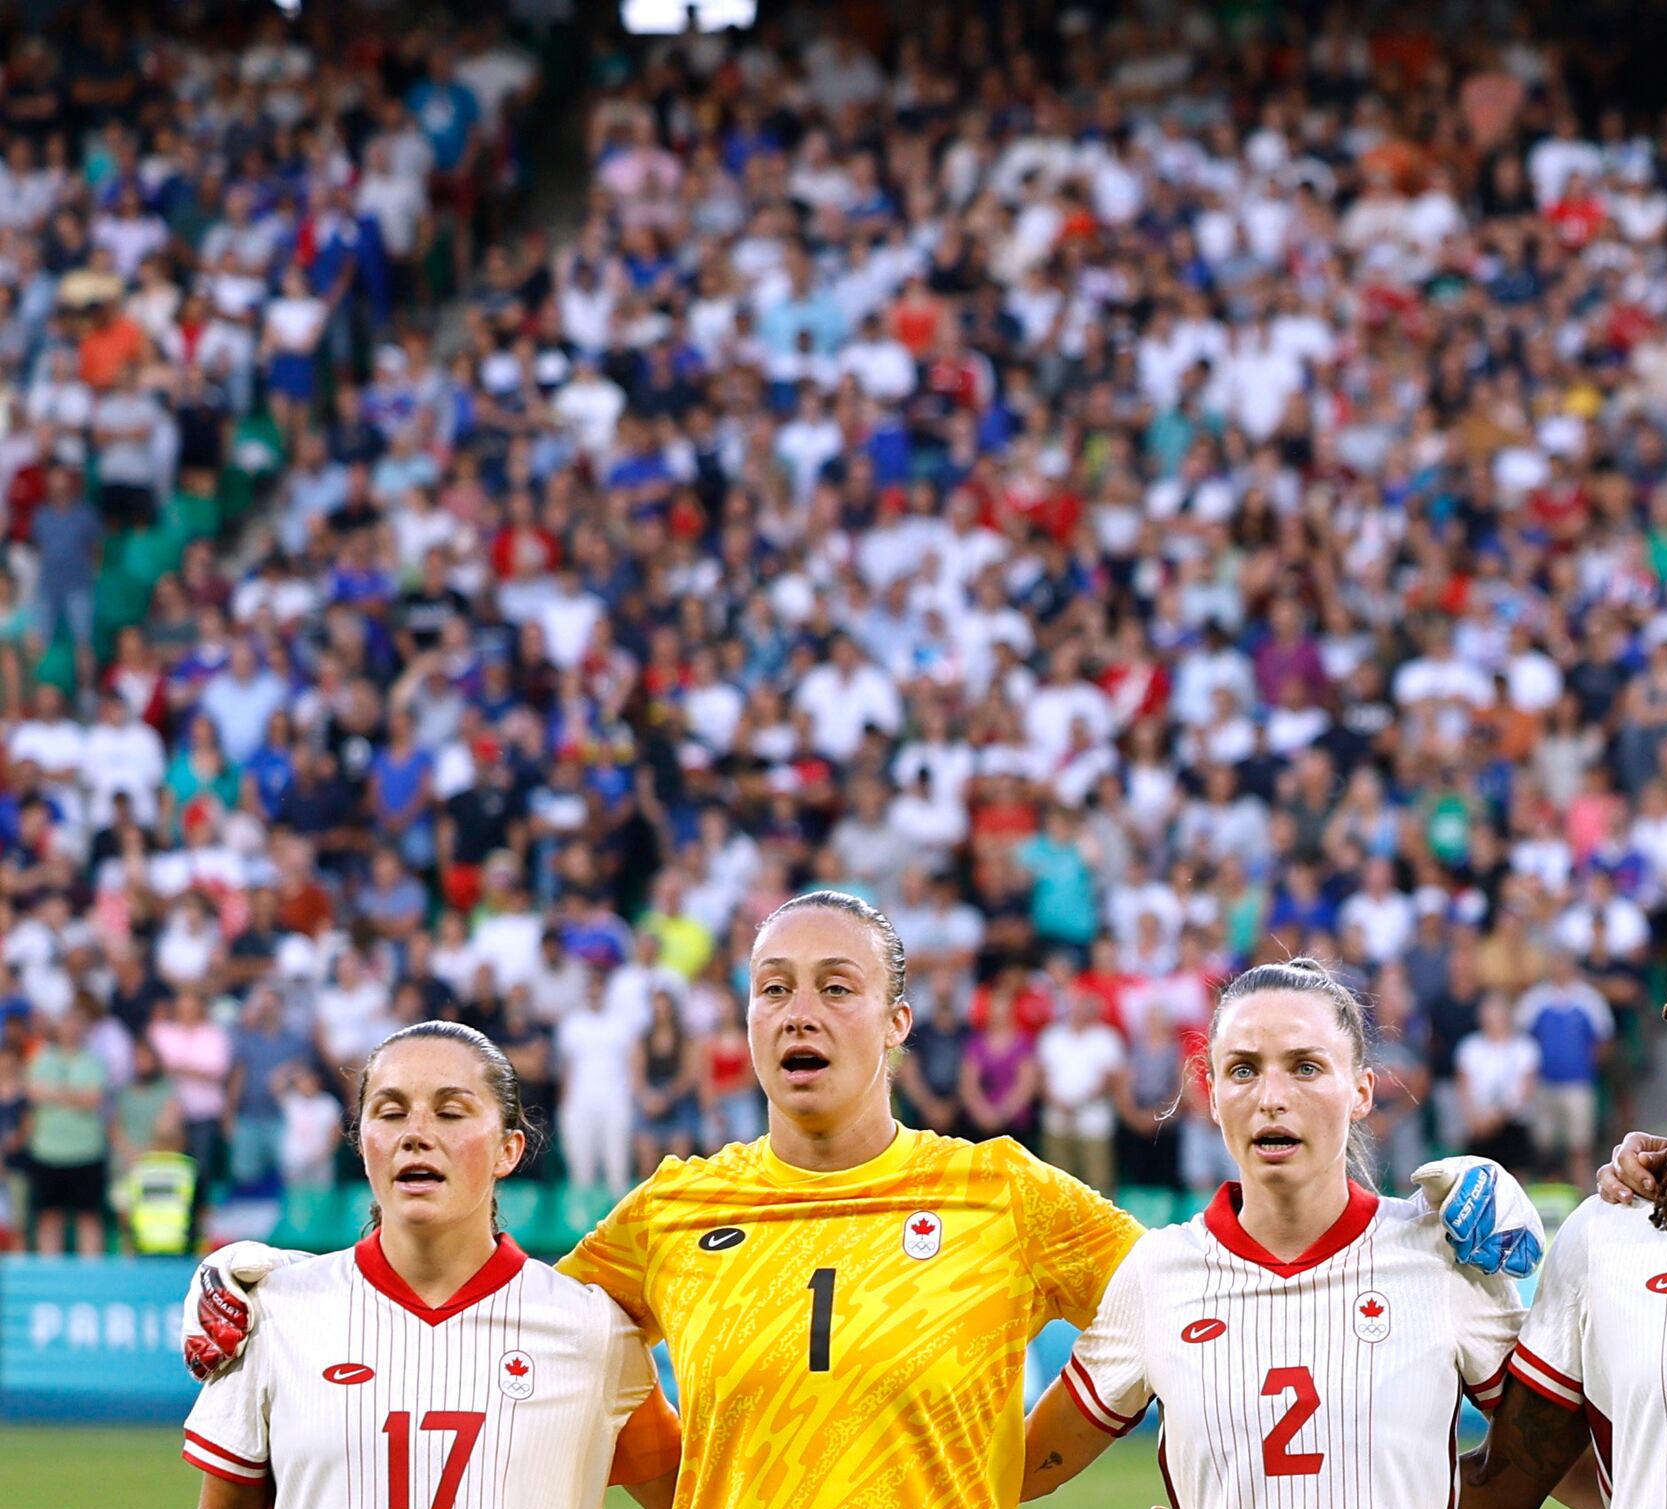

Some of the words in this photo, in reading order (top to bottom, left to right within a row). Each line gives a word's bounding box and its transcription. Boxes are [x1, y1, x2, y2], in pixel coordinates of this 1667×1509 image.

[1452, 1197, 1475, 1227] WEST
[1471, 1169, 1488, 1200] COAST
[808, 1268, 836, 1372] 1
[1260, 1365, 1324, 1477] 2
